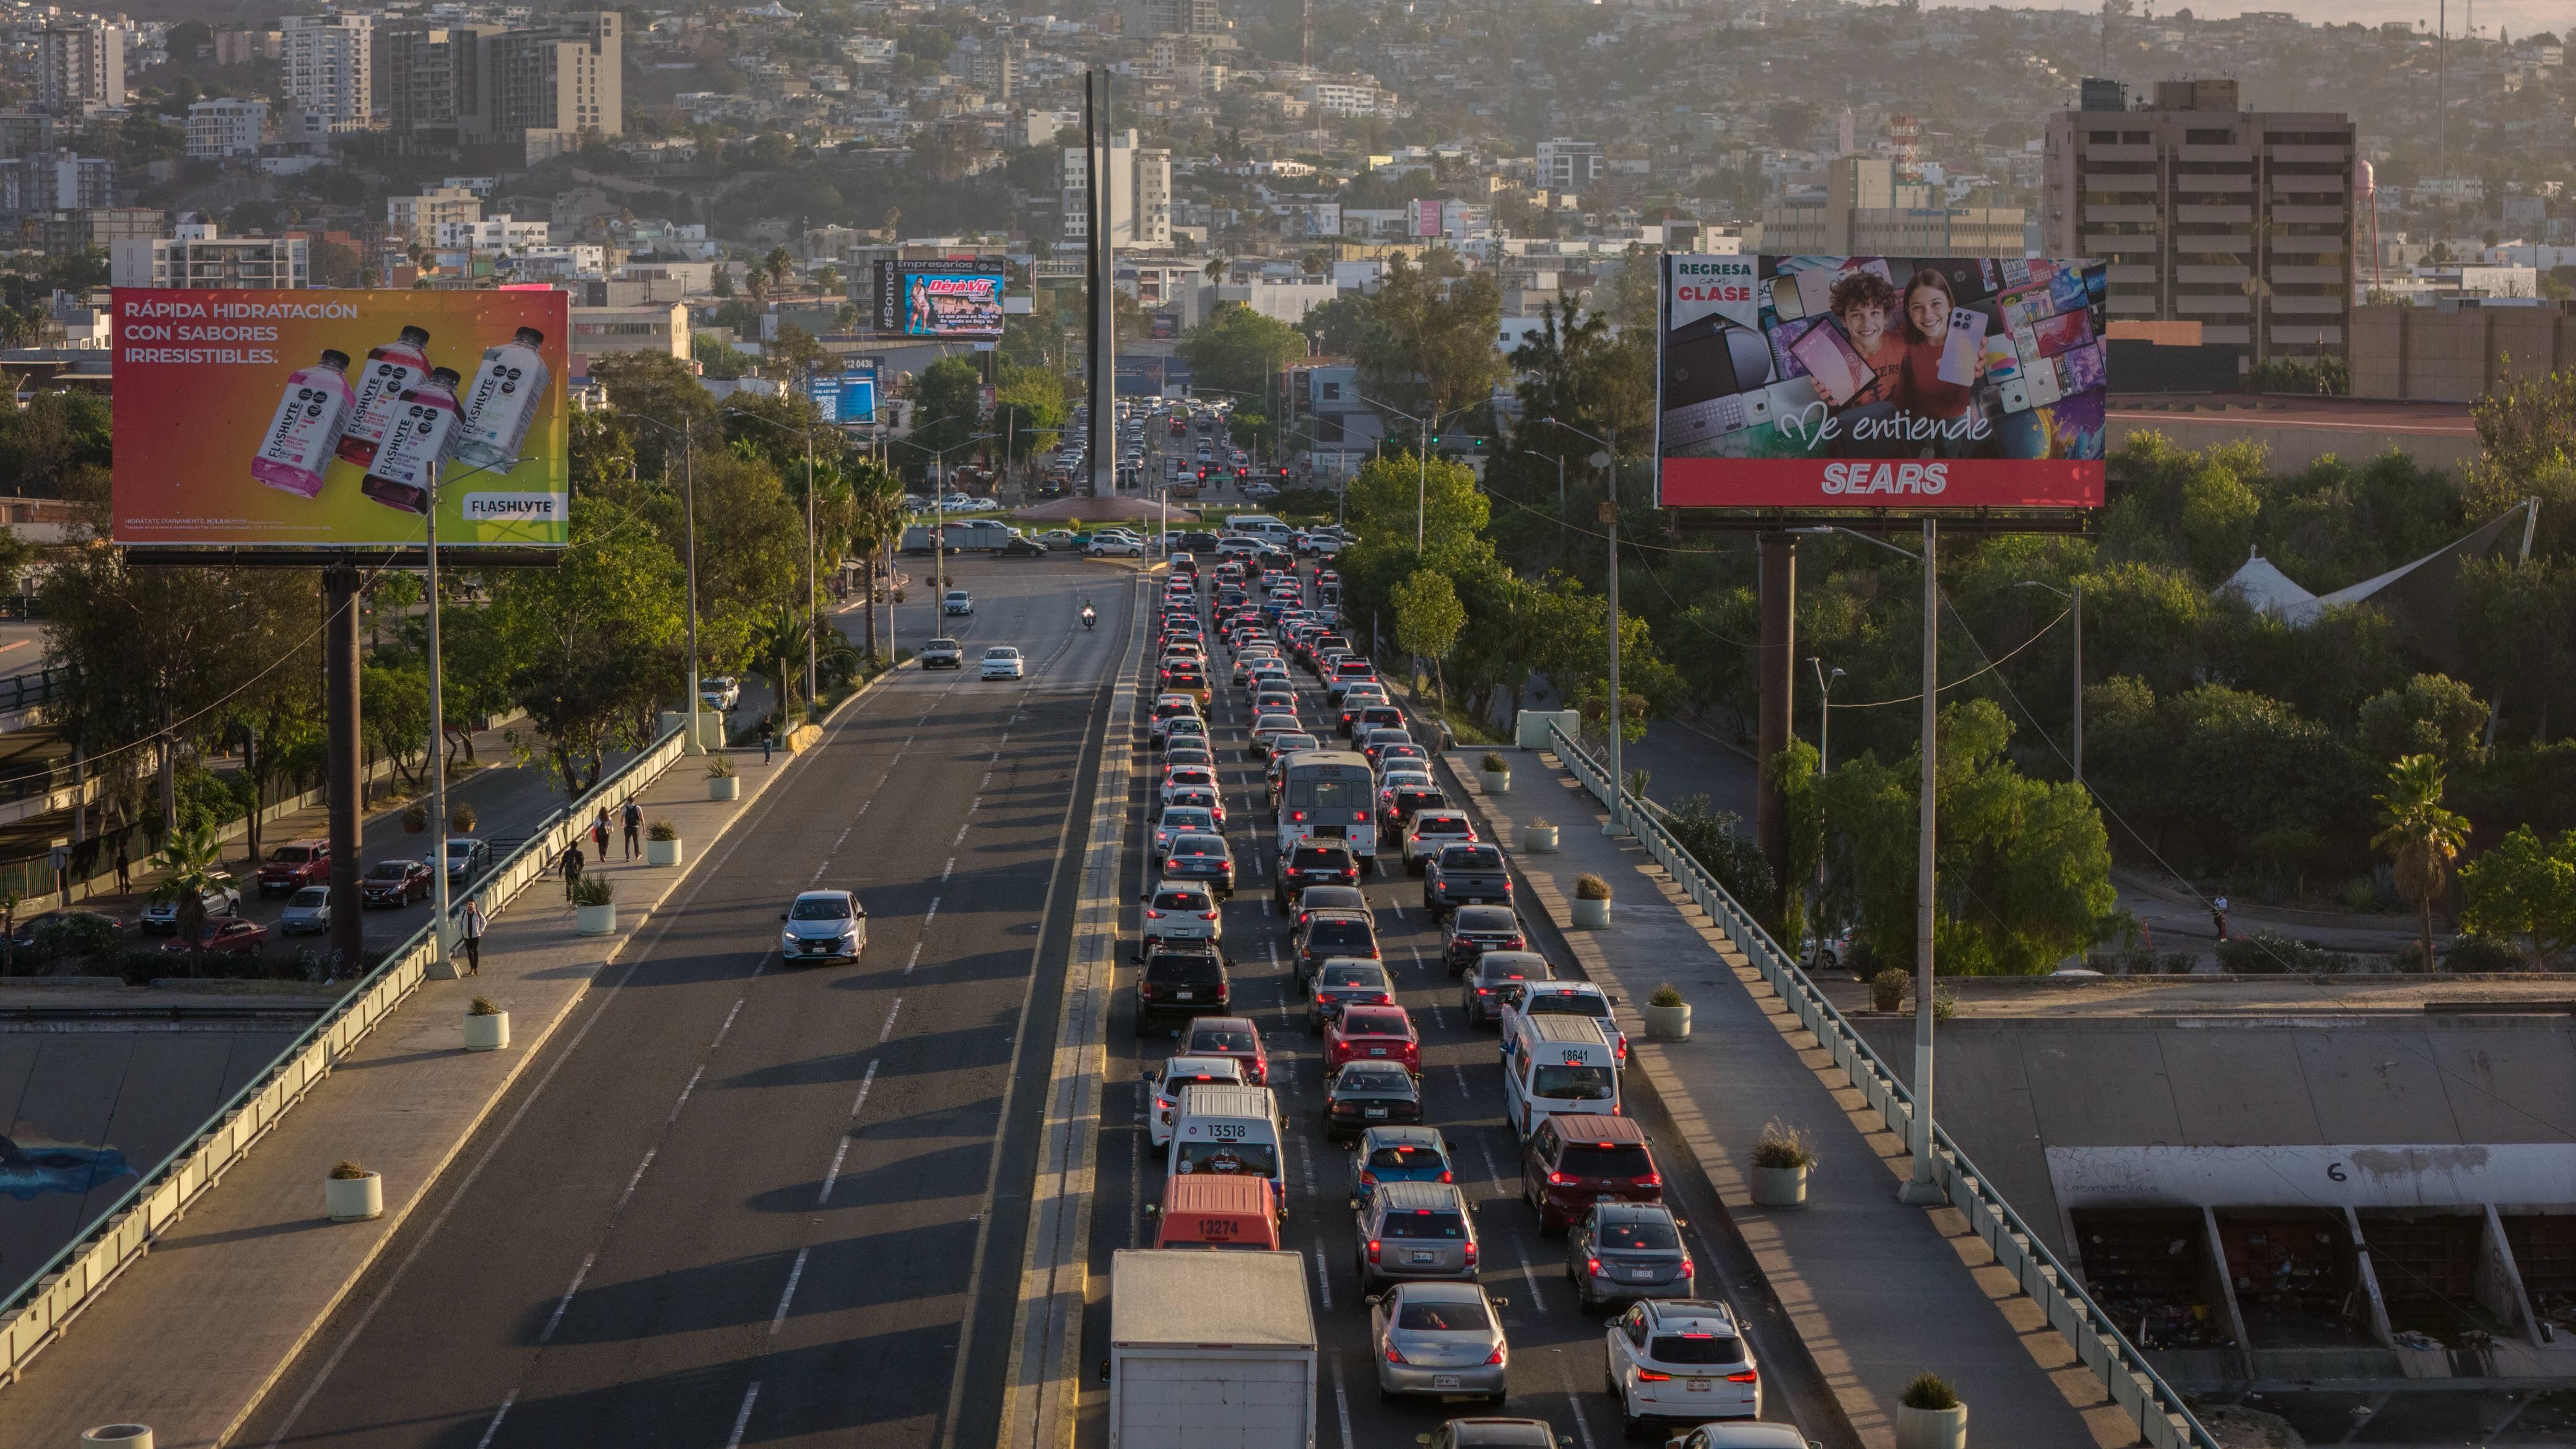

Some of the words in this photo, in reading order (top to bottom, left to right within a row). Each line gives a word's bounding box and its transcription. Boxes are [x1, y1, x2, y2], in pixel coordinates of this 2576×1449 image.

[1679, 263, 1752, 276] REGRESA
[967, 279, 995, 292] Vu
[1678, 286, 1750, 301] CLASE
[884, 261, 894, 328] #Somos
[125, 299, 207, 318] RÁPIDA
[214, 300, 357, 318] HIDRATACIÓN
[124, 325, 171, 341] CON
[178, 326, 278, 341] SABORES
[125, 348, 278, 363] IRRESISTIBLES.
[856, 360, 873, 368] 0438
[348, 377, 380, 433] FLASHLYTE
[463, 378, 494, 434] FLASHLYTE
[268, 401, 301, 458] FLASHLYTE
[1780, 401, 1842, 451] Me
[1853, 406, 1992, 440] entiende
[379, 419, 411, 476] FLASHLYTE
[1821, 463, 1948, 495] SEARS
[472, 501, 551, 513] FLASHLYTE
[1562, 1050, 1588, 1061] 18641
[1208, 1125, 1245, 1137] 13518
[2327, 1162, 2347, 1181] 6
[1199, 1219, 1238, 1235] 13274
